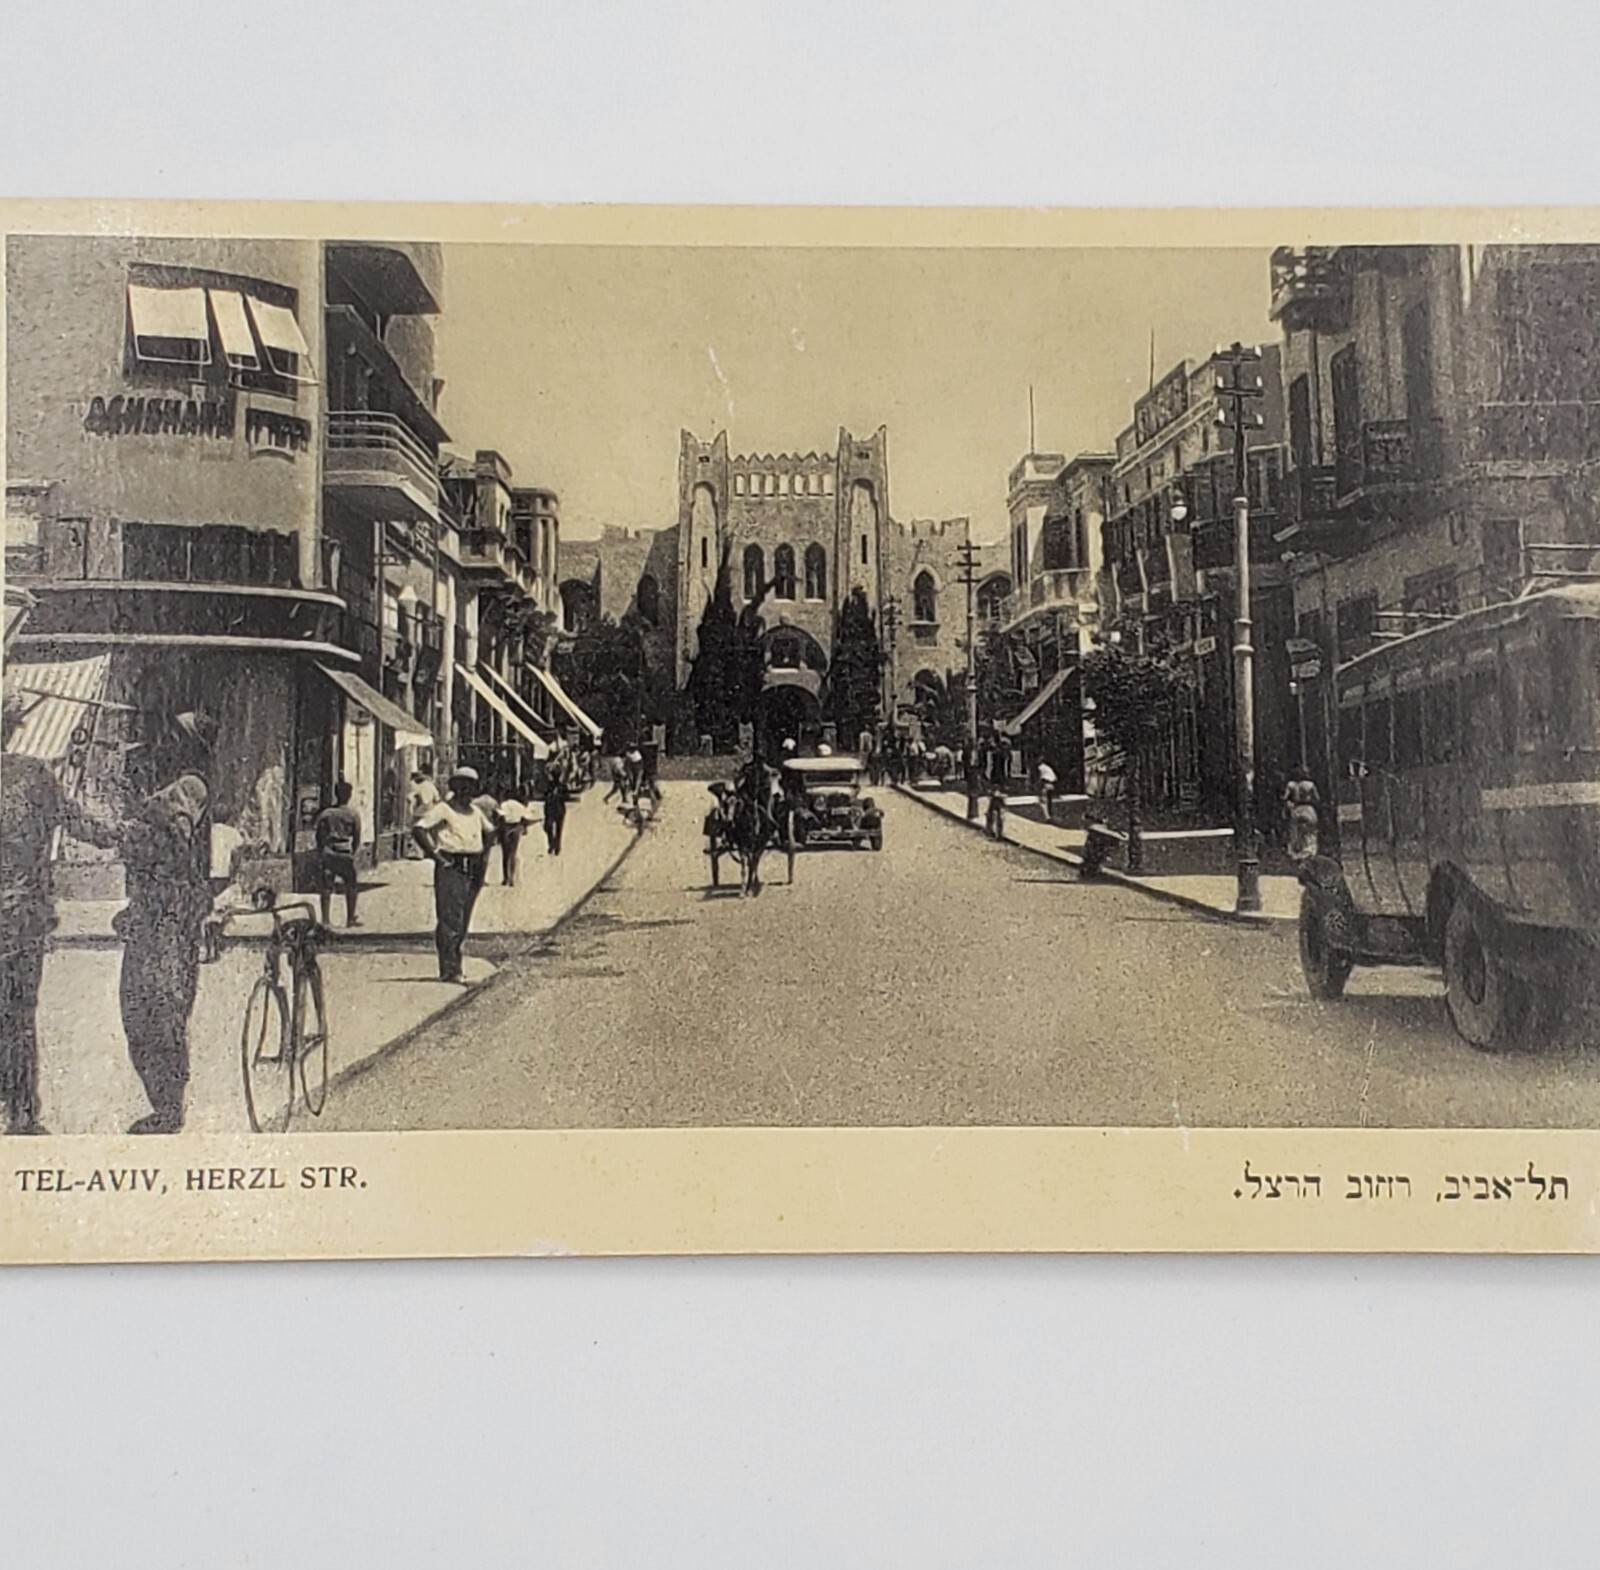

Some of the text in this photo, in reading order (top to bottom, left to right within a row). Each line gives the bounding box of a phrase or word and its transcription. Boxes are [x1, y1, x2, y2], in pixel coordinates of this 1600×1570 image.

[14, 1166, 367, 1194] TEL-AVIV, HERZL STR.
[1233, 1160, 1321, 1199] הרצל.
[1345, 1175, 1411, 1199] רחוב
